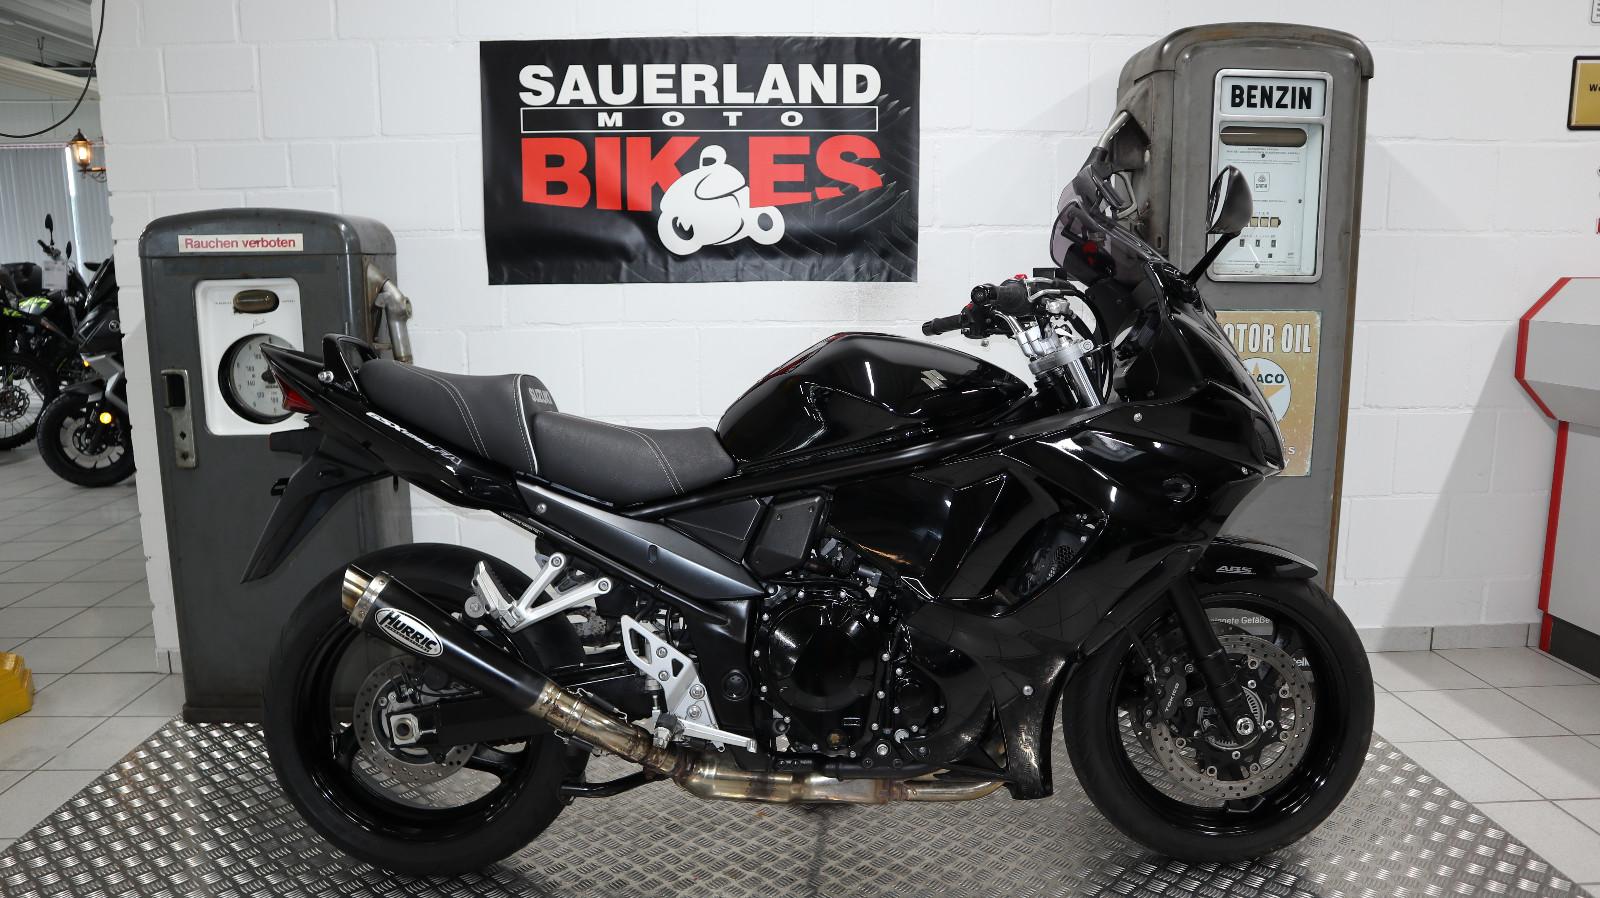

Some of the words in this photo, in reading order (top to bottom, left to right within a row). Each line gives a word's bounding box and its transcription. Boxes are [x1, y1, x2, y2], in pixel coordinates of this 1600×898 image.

[518, 63, 882, 107] SAUERLAND
[1231, 84, 1312, 110] BENZIN
[597, 110, 804, 128] MOTO
[521, 134, 883, 212] BIKES
[184, 237, 239, 249] Rauchen
[242, 237, 296, 249] verboten
[1219, 323, 1275, 353] OTOR
[1281, 323, 1312, 353] OIL
[1256, 373, 1285, 384] ACO
[379, 609, 438, 651] HURRIC
